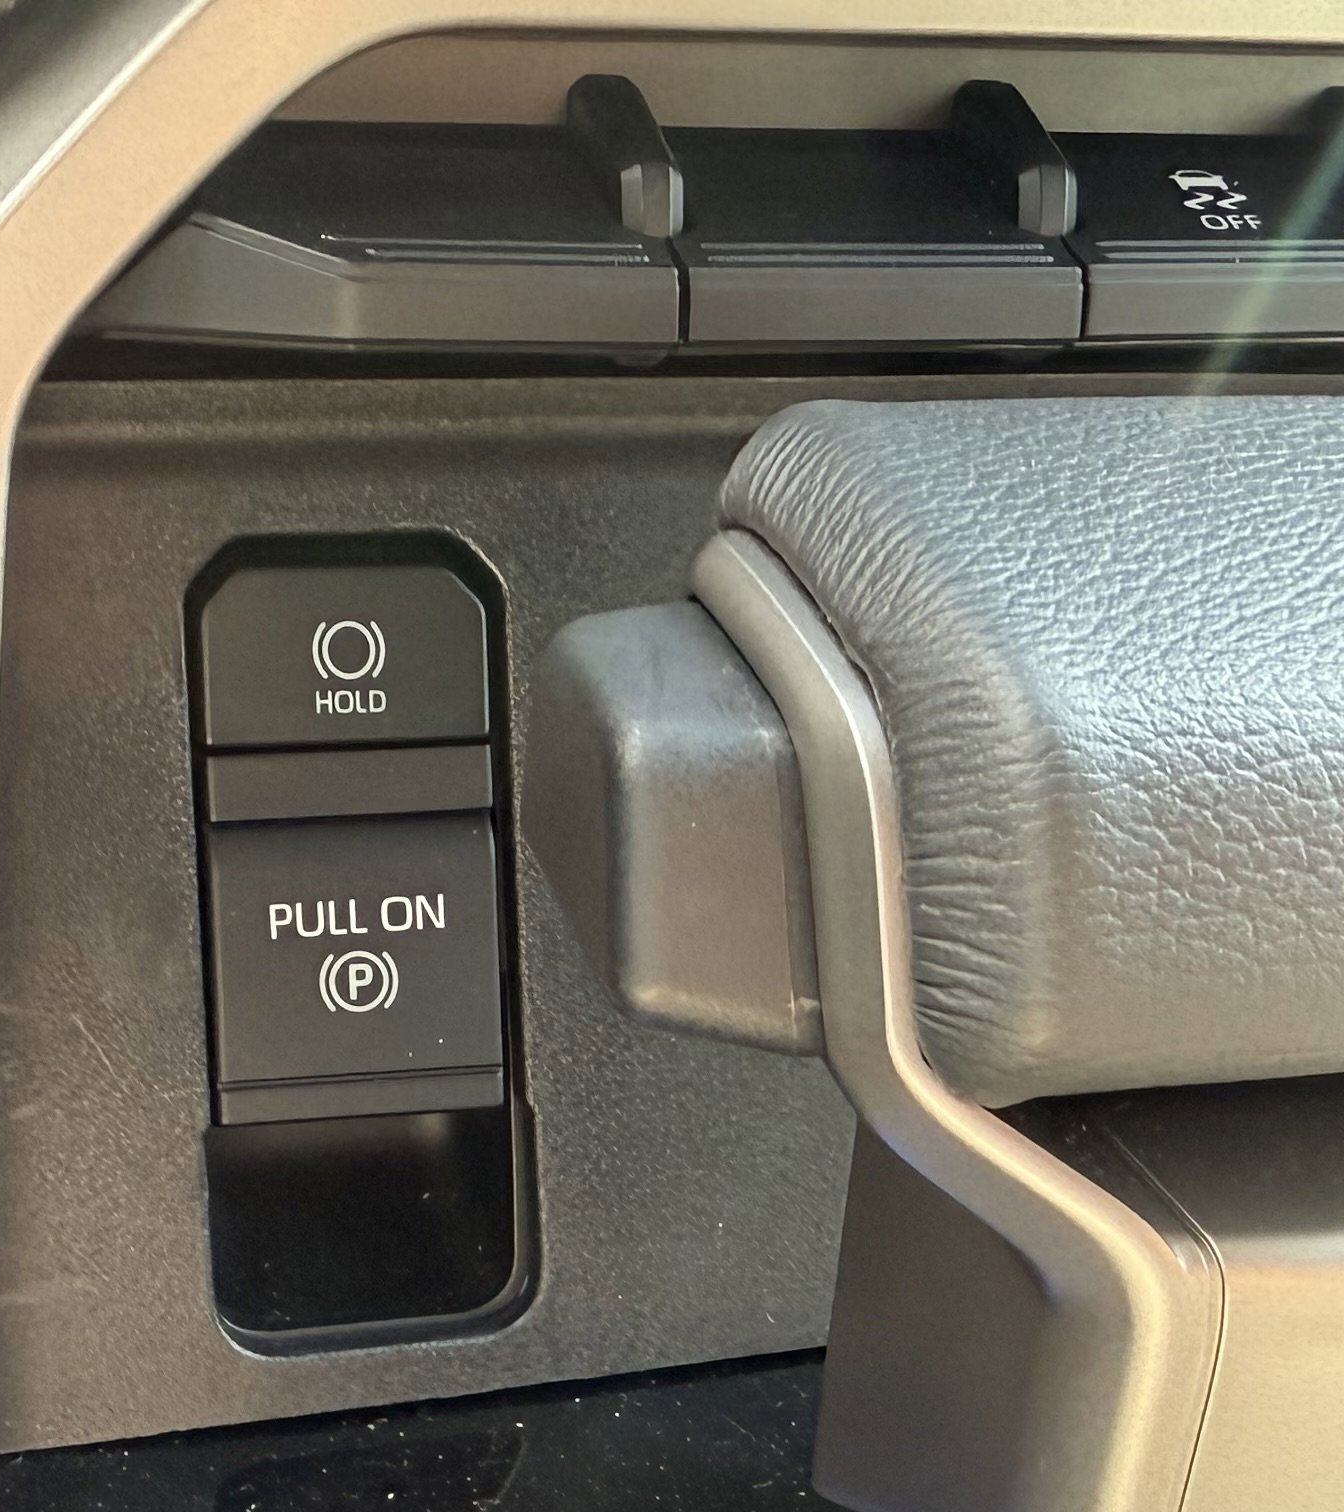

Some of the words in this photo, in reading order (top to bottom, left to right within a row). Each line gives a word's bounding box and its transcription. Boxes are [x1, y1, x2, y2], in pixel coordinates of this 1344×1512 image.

[1200, 214, 1261, 230] OFF
[315, 689, 387, 715] HOLD
[268, 898, 369, 940] PULL
[380, 893, 446, 932] ON
